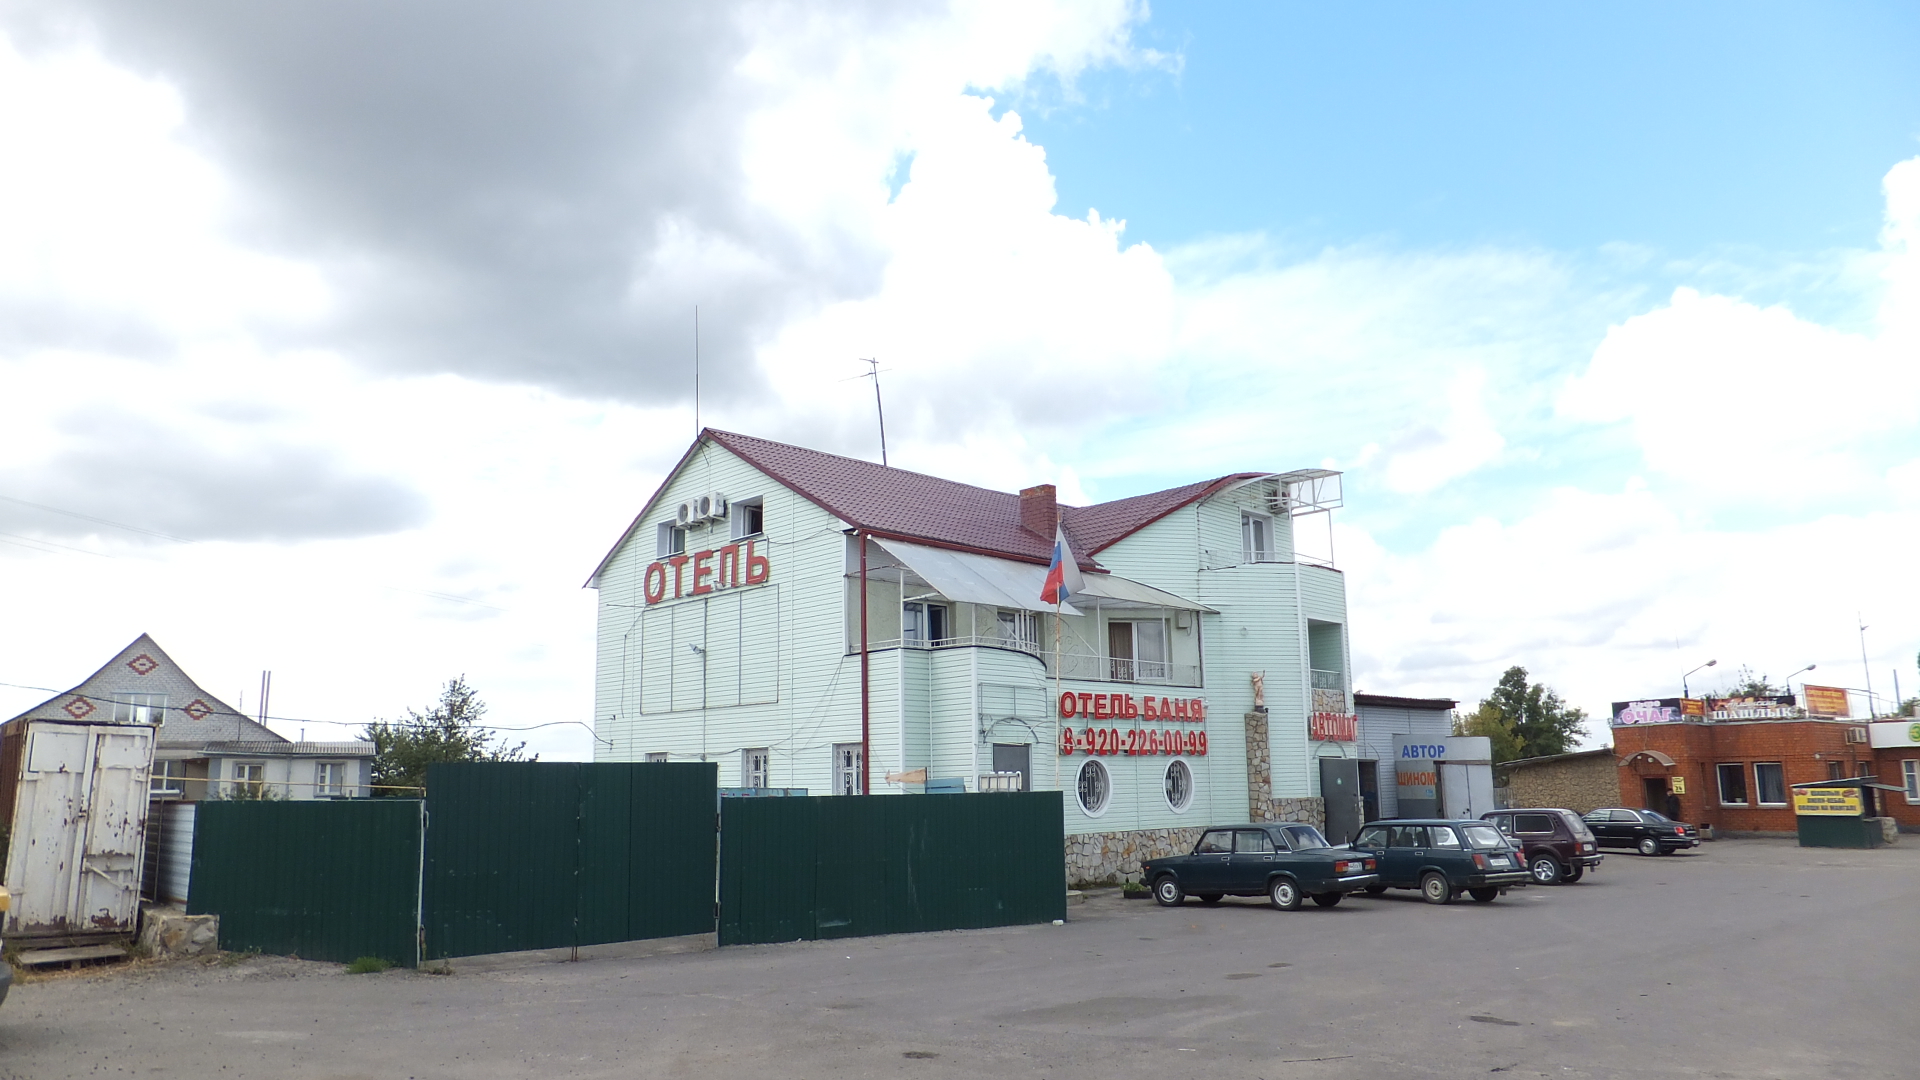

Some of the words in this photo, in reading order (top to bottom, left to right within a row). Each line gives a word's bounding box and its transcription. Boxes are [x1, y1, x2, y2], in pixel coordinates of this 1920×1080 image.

[644, 540, 769, 604] ОТЕЛЬ
[1060, 691, 1138, 720] ОТЕЛЬ
[1143, 695, 1204, 722] БАНЯ
[1713, 706, 1794, 720] ШАШЛЫК
[1063, 727, 1208, 756] 8-920-226-00-99
[1401, 744, 1446, 759] АВТОР
[1397, 771, 1437, 786] ШИНОМ
